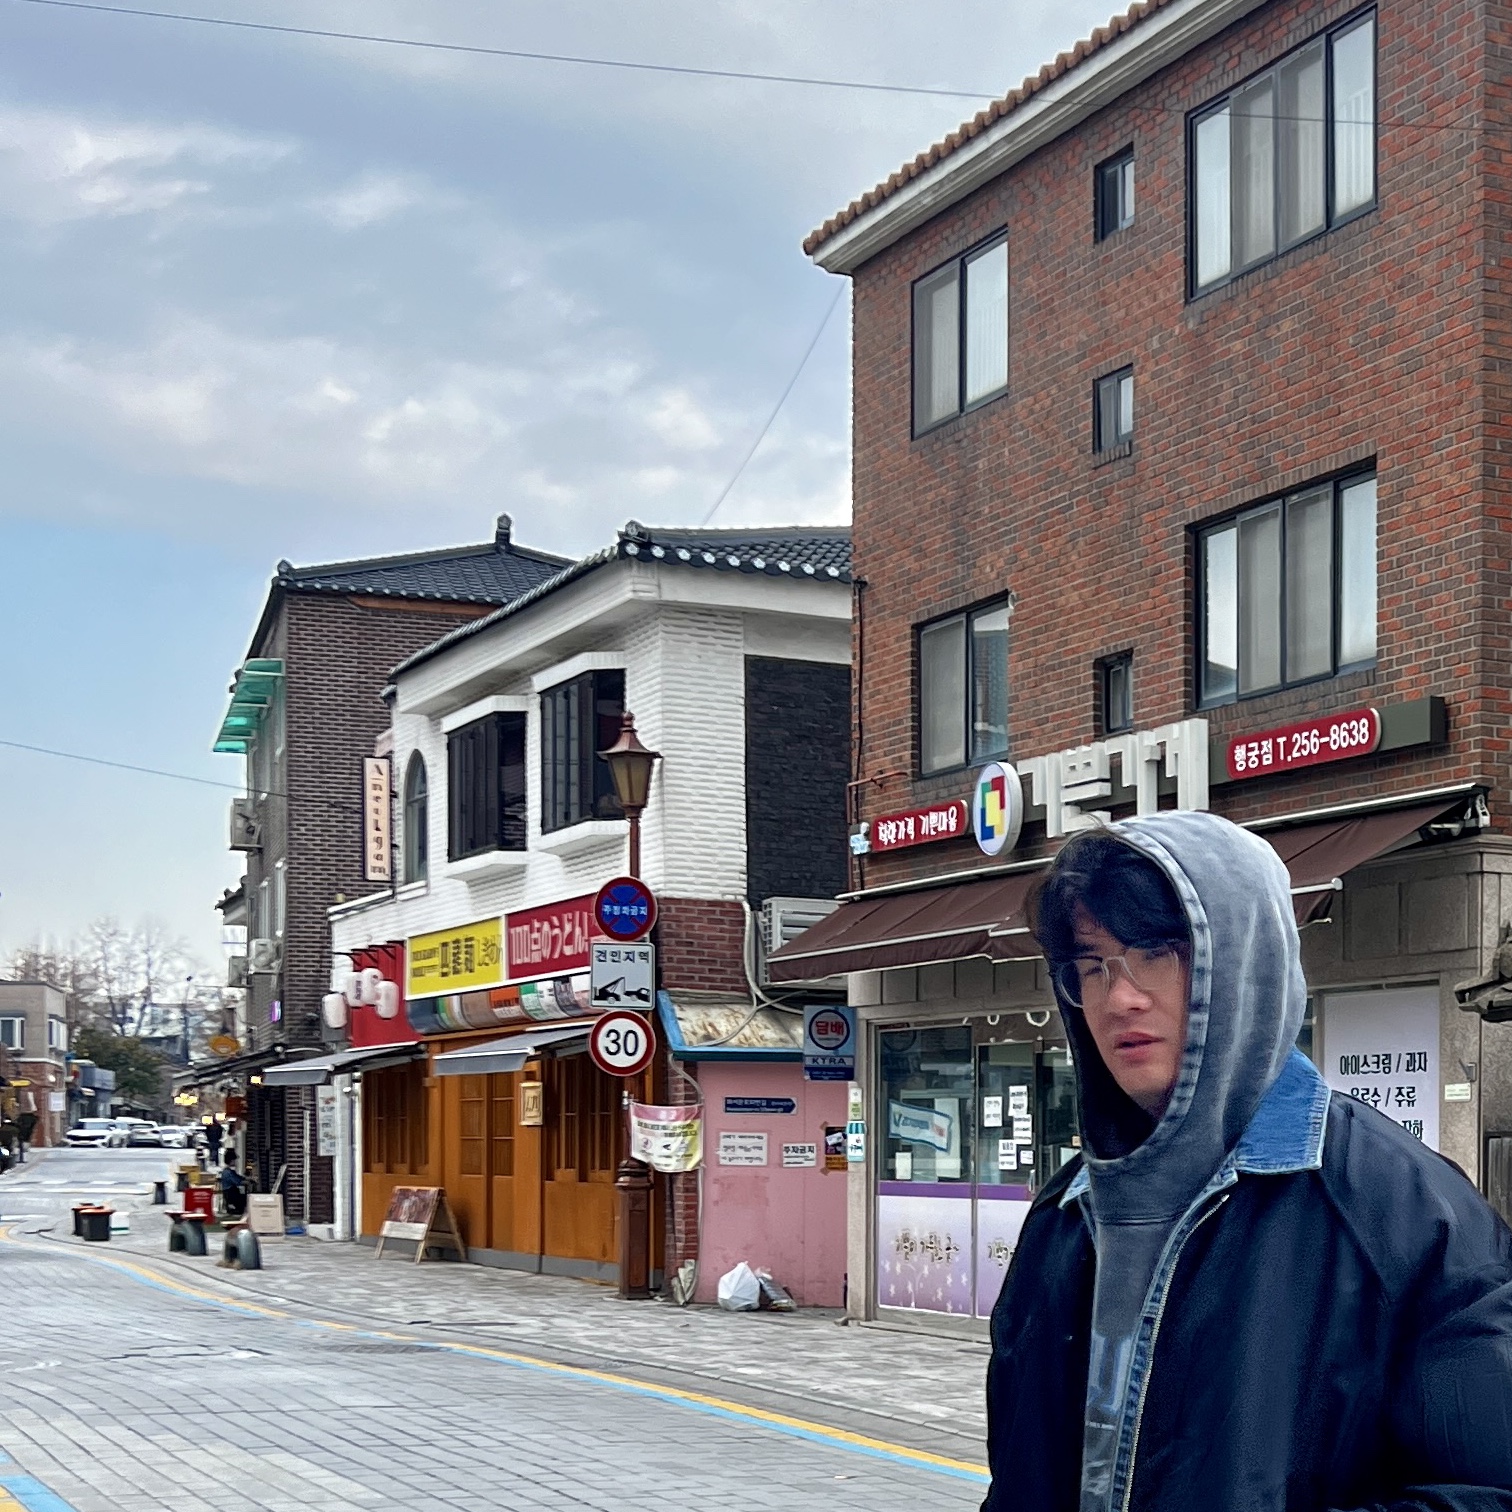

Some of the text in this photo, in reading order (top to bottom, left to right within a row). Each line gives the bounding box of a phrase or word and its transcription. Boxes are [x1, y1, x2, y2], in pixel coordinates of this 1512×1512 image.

[1233, 717, 1370, 772] 행궁점 T.256-8638
[918, 805, 958, 836] 기쁜마음
[602, 904, 648, 916] 주정차금지
[595, 950, 650, 964] 견인지역
[815, 1020, 845, 1036] 담배
[604, 1028, 639, 1057] 30
[812, 1057, 847, 1065] KTRA
[1340, 1053, 1392, 1075] 아이스크림
[1405, 1051, 1428, 1073] 과자
[1394, 1086, 1417, 1108] 주류
[783, 1146, 815, 1154] 주차금지
